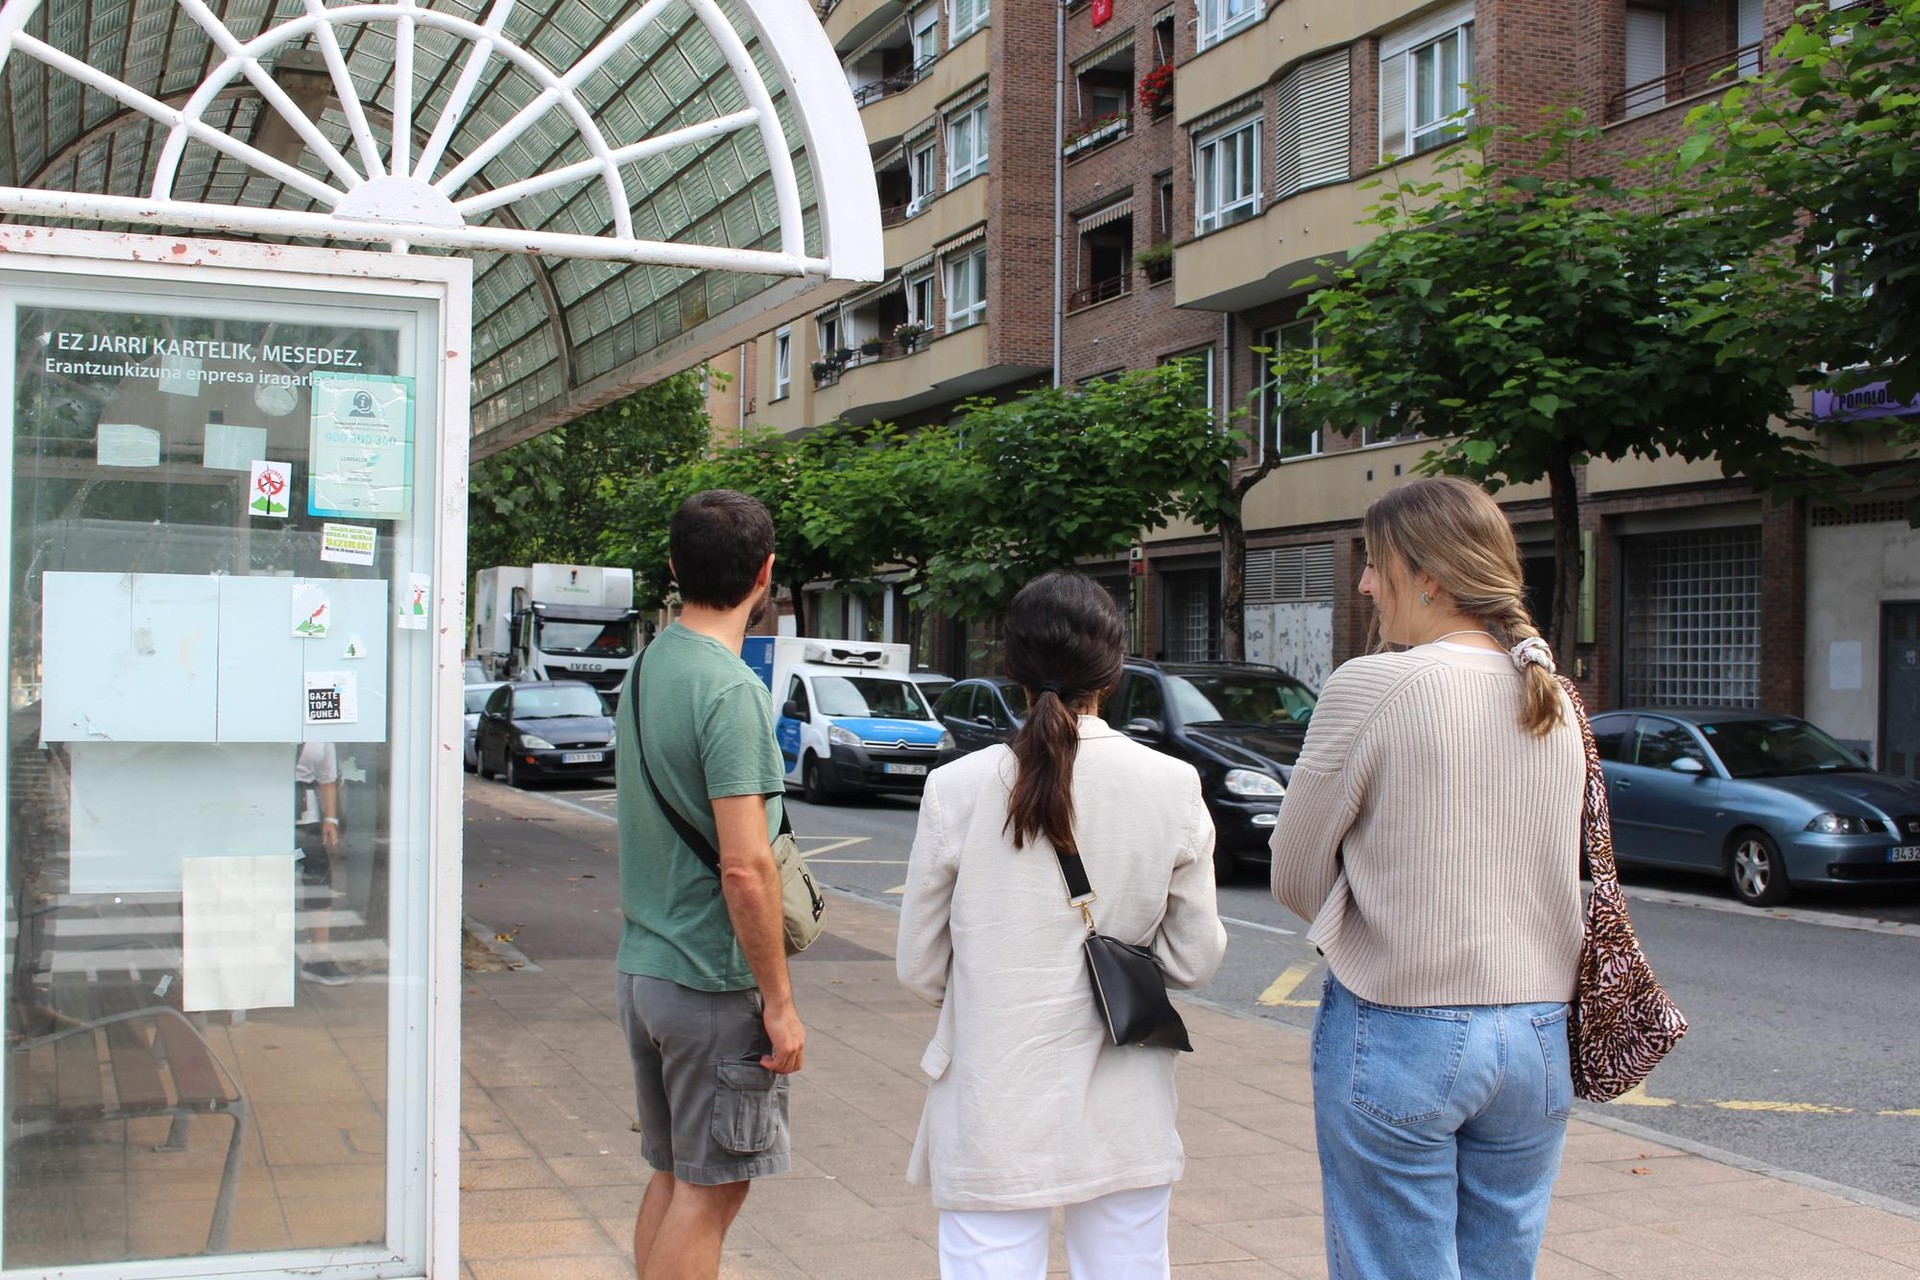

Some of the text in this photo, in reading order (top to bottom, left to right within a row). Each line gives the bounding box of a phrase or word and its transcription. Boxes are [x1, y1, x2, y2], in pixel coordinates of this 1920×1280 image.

[58, 332, 363, 367] EZ JARRI KARTELIK, MESEDEZ.
[45, 357, 182, 380] Erantzunkizuna
[186, 368, 254, 385] enpresa
[570, 662, 603, 671] IVECO
[309, 691, 339, 701] GAZTE
[310, 701, 339, 710] TOPA-
[310, 709, 340, 719] GUNEA
